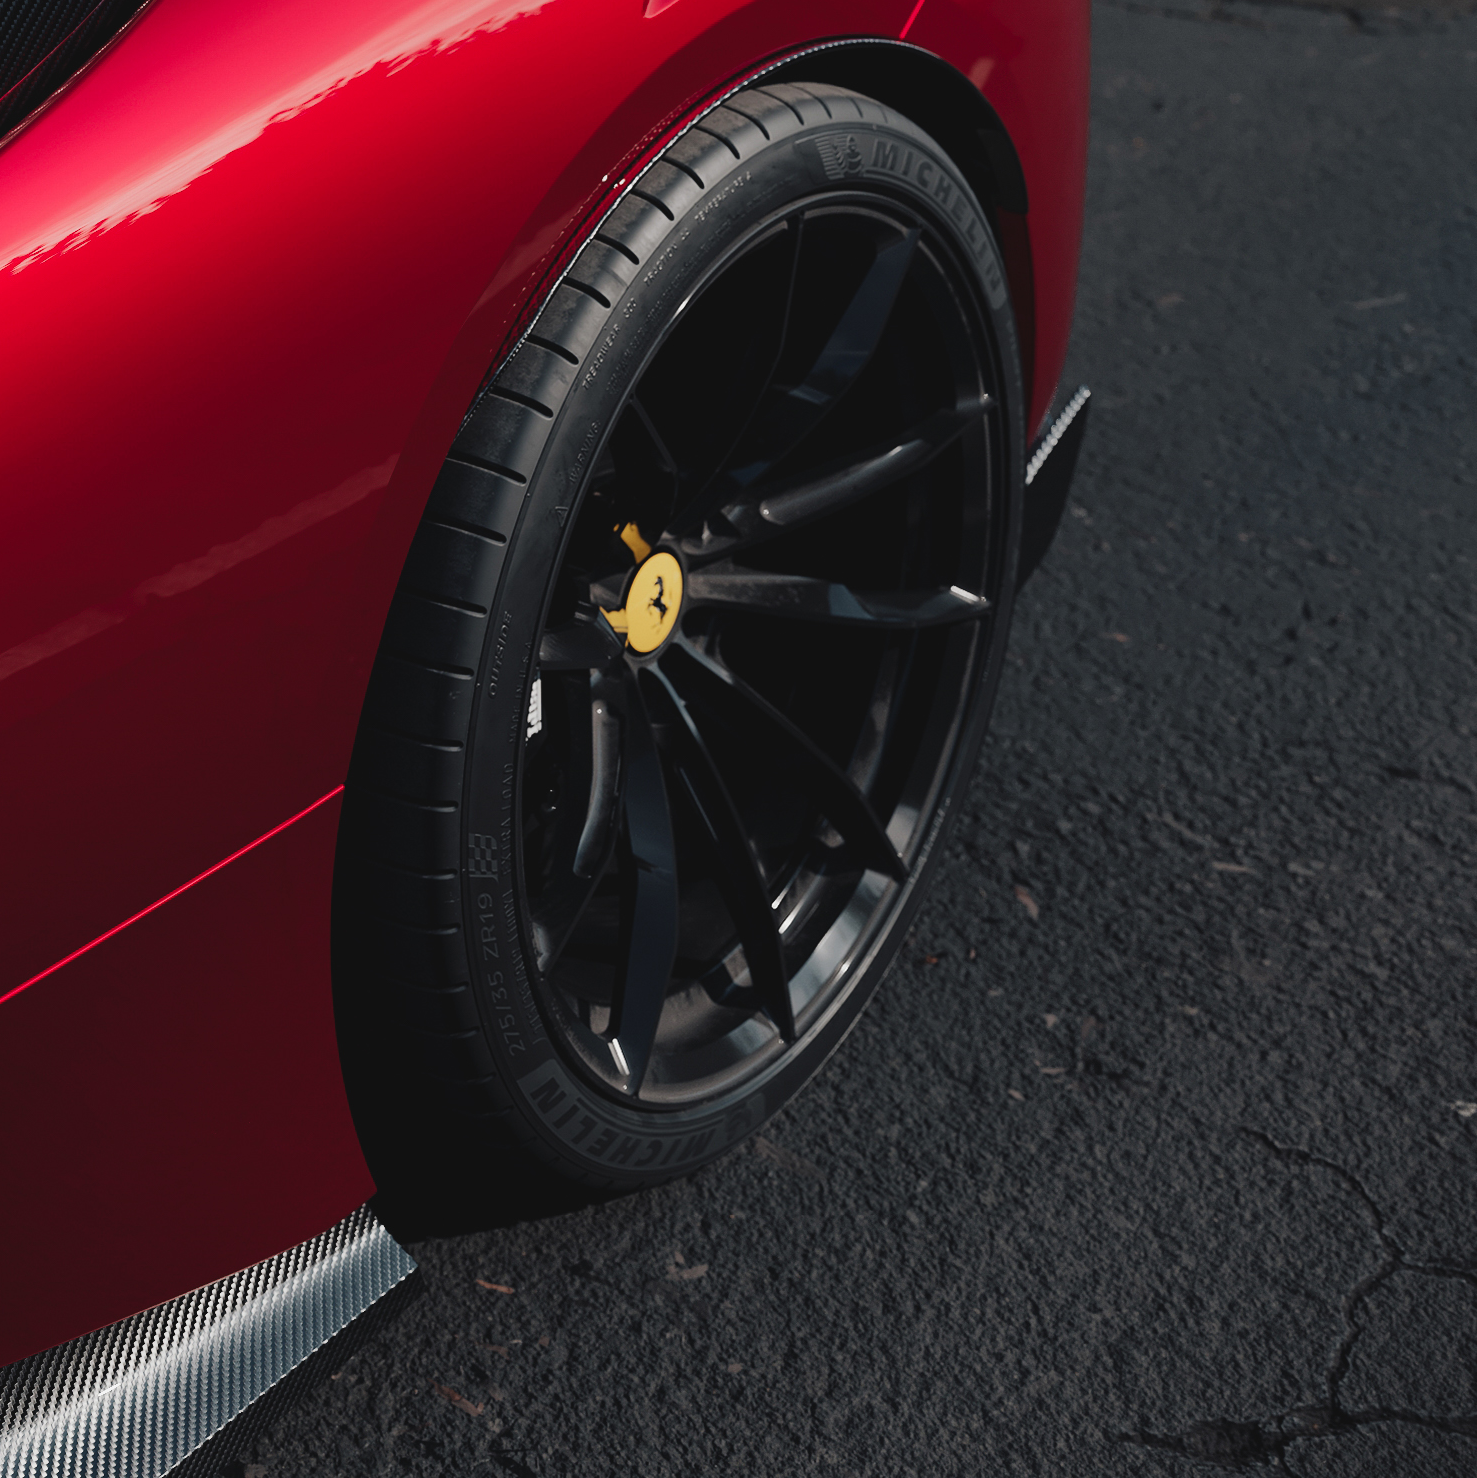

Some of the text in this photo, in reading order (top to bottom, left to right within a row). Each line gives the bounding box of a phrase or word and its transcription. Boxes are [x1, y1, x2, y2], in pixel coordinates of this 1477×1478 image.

[873, 138, 1002, 293] MICHELIN
[582, 324, 621, 390] TREADWEAR
[643, 244, 678, 288] TRACTION
[488, 610, 513, 698] OUTSIDE
[501, 762, 514, 812] LOAD
[500, 817, 512, 876] EXTRA
[477, 892, 526, 1057] 275/35 ZR19
[530, 1077, 719, 1168] MICHELIN
